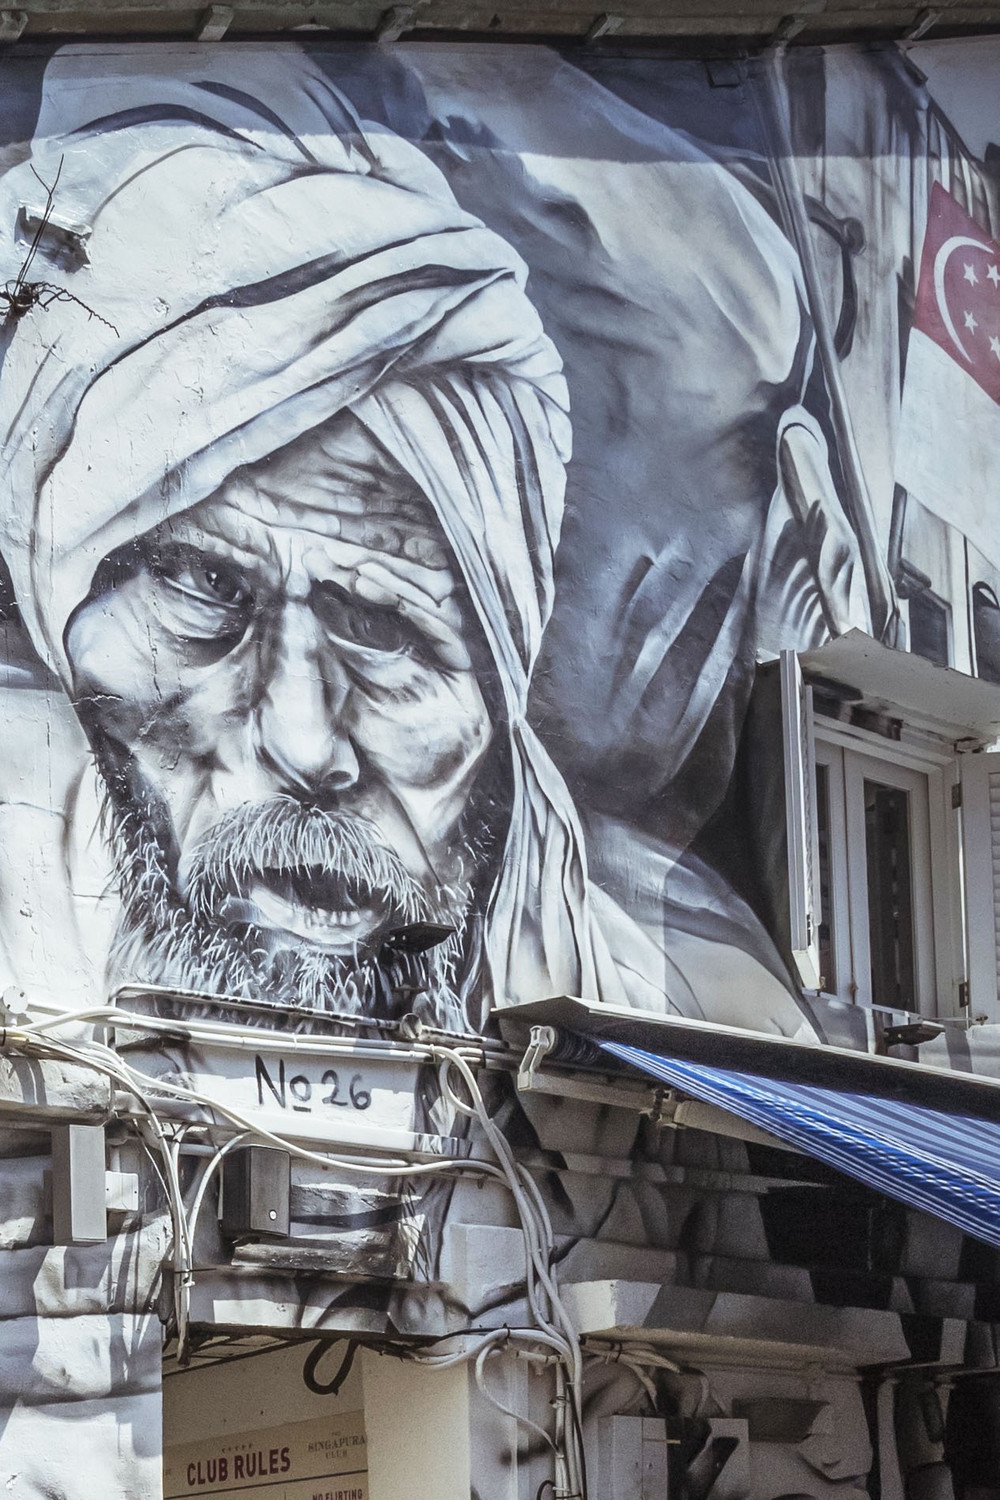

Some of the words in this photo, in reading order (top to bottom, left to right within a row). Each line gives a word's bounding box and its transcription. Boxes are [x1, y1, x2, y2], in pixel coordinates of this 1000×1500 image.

[308, 1435, 366, 1452] SINGAPURA
[187, 1458, 228, 1486] CLUB
[234, 1447, 291, 1480] RULES
